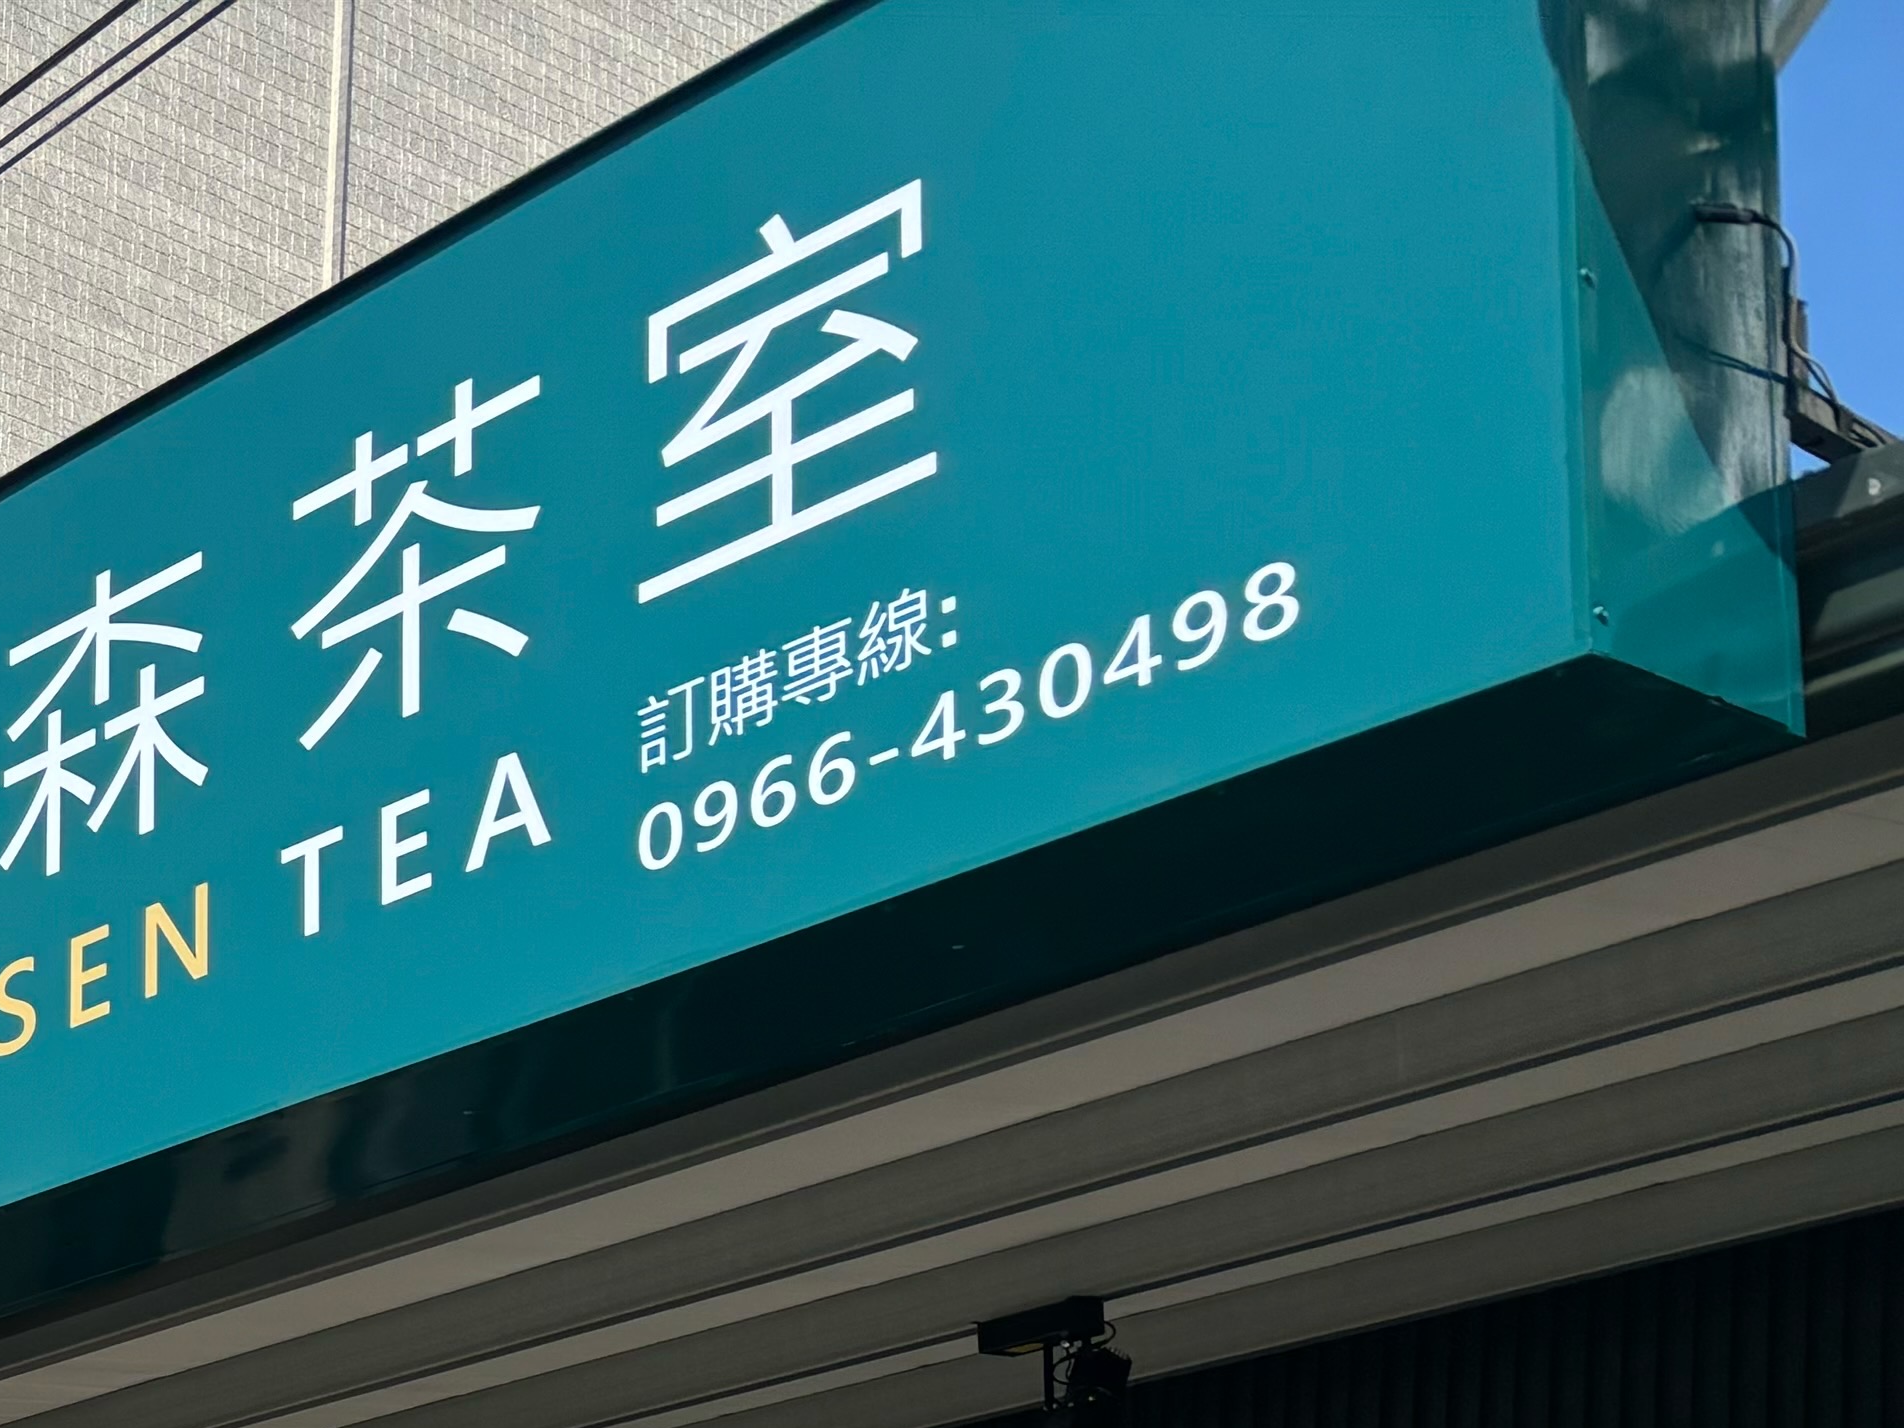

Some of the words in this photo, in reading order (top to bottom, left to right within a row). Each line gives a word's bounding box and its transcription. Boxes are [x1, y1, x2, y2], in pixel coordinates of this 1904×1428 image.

[635, 555, 1304, 874] 0966-430498
[636, 589, 963, 776] 訂購專線:
[280, 749, 556, 940] TEA
